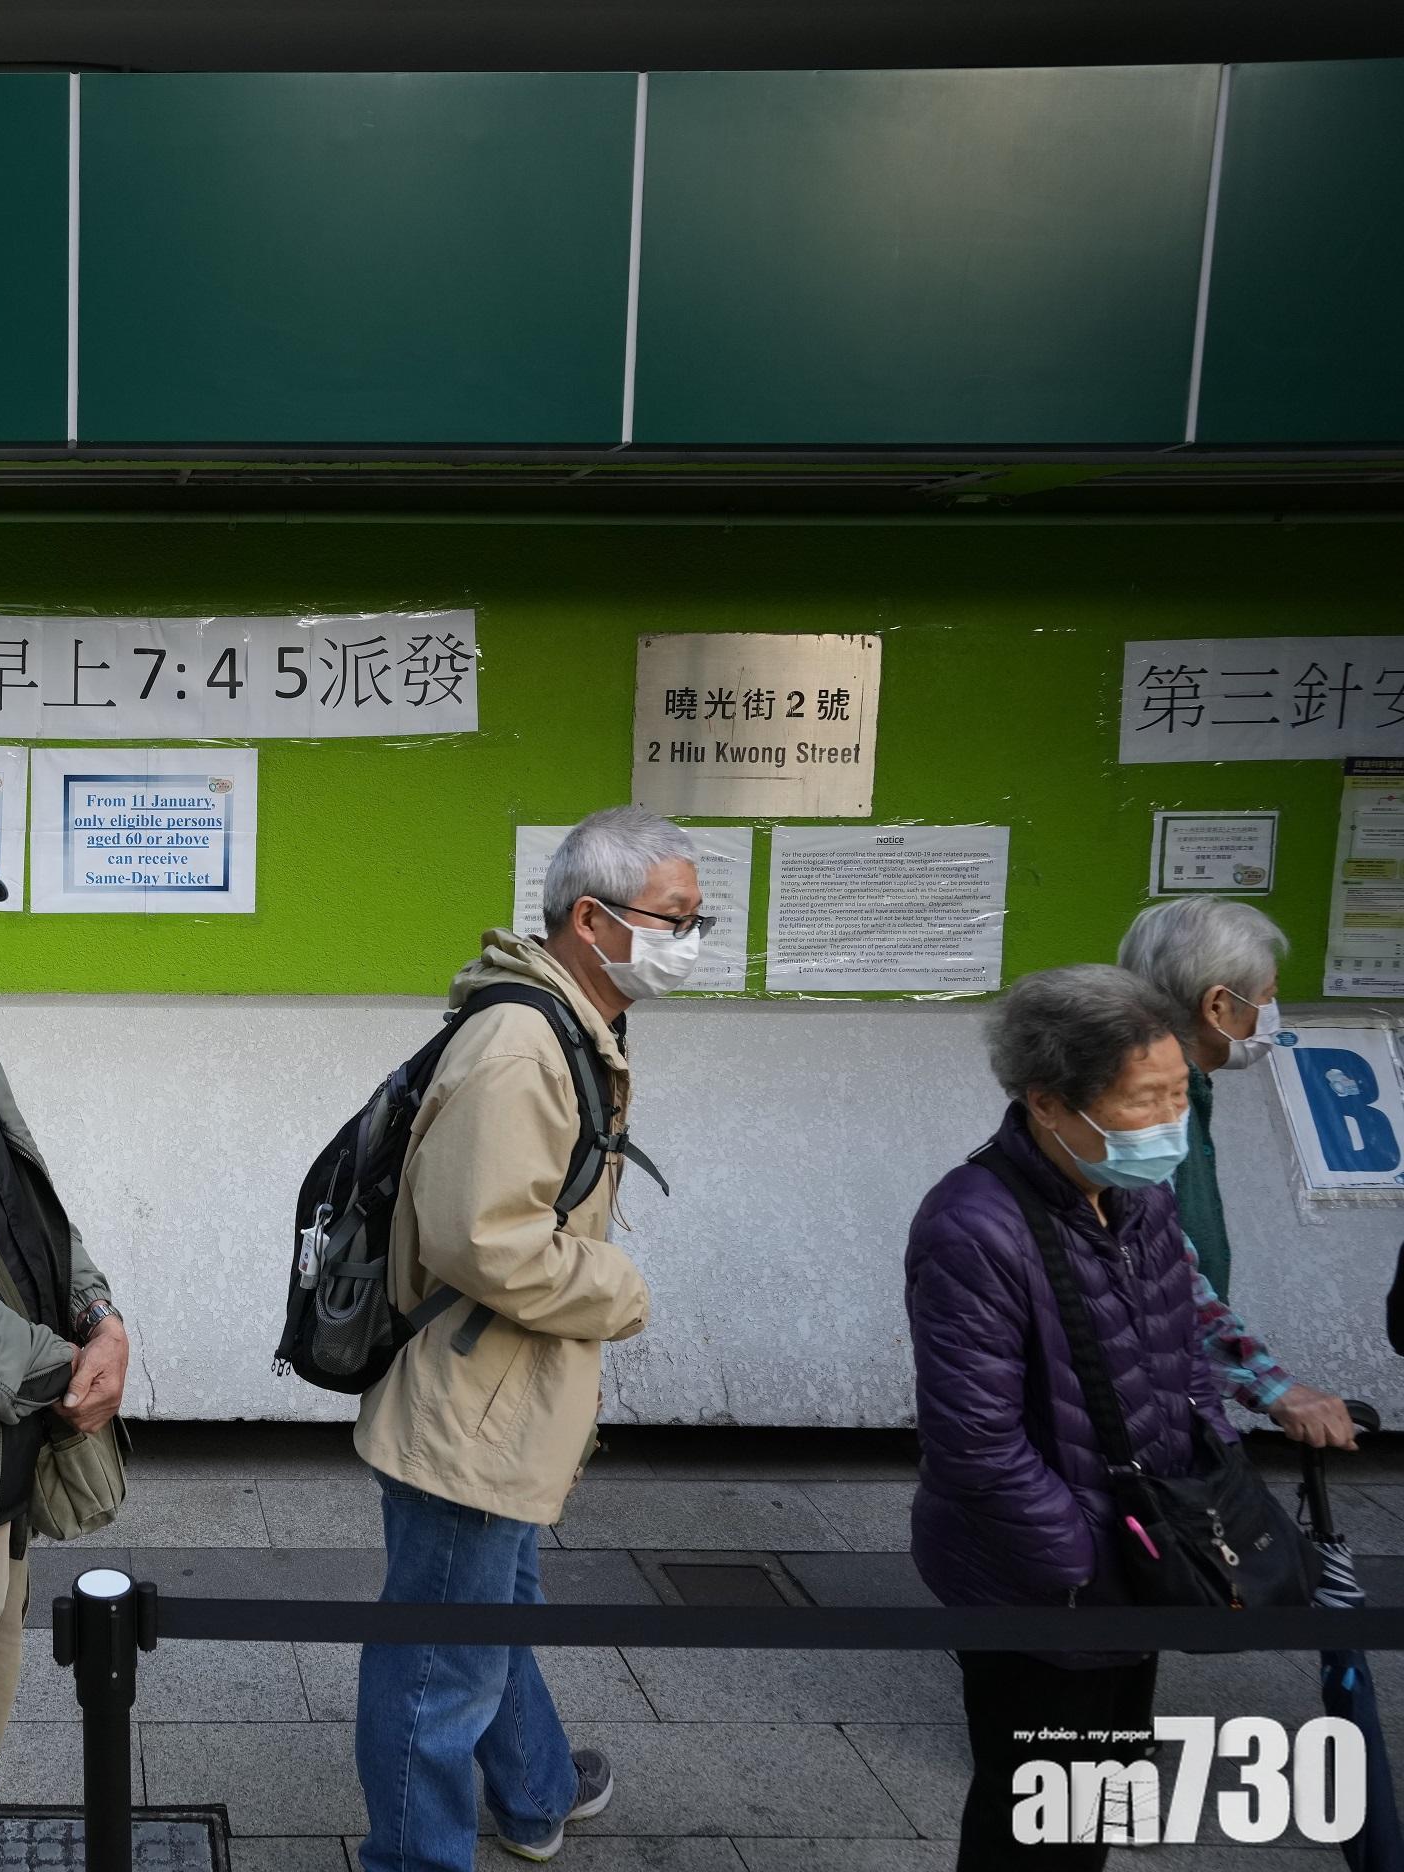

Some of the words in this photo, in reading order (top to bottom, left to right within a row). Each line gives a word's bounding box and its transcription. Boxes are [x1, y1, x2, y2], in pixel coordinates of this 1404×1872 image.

[648, 742, 660, 762] 2
[670, 741, 705, 762] Hiu
[716, 741, 786, 768] Kwong
[796, 742, 860, 763] Street
[86, 795, 126, 807] From
[131, 795, 145, 807] 11
[151, 795, 216, 809] January,
[74, 814, 105, 828] only
[110, 814, 162, 828] eligible
[167, 817, 222, 829] persons
[87, 833, 120, 847] aged
[126, 833, 142, 845] 60
[146, 836, 162, 845] or
[166, 833, 209, 845] above
[876, 836, 904, 845] Notice
[108, 855, 132, 865] can
[138, 852, 188, 865] receive
[85, 872, 159, 887] Same-Day
[164, 871, 210, 884] Ticket
[1292, 1048, 1401, 1172] B
